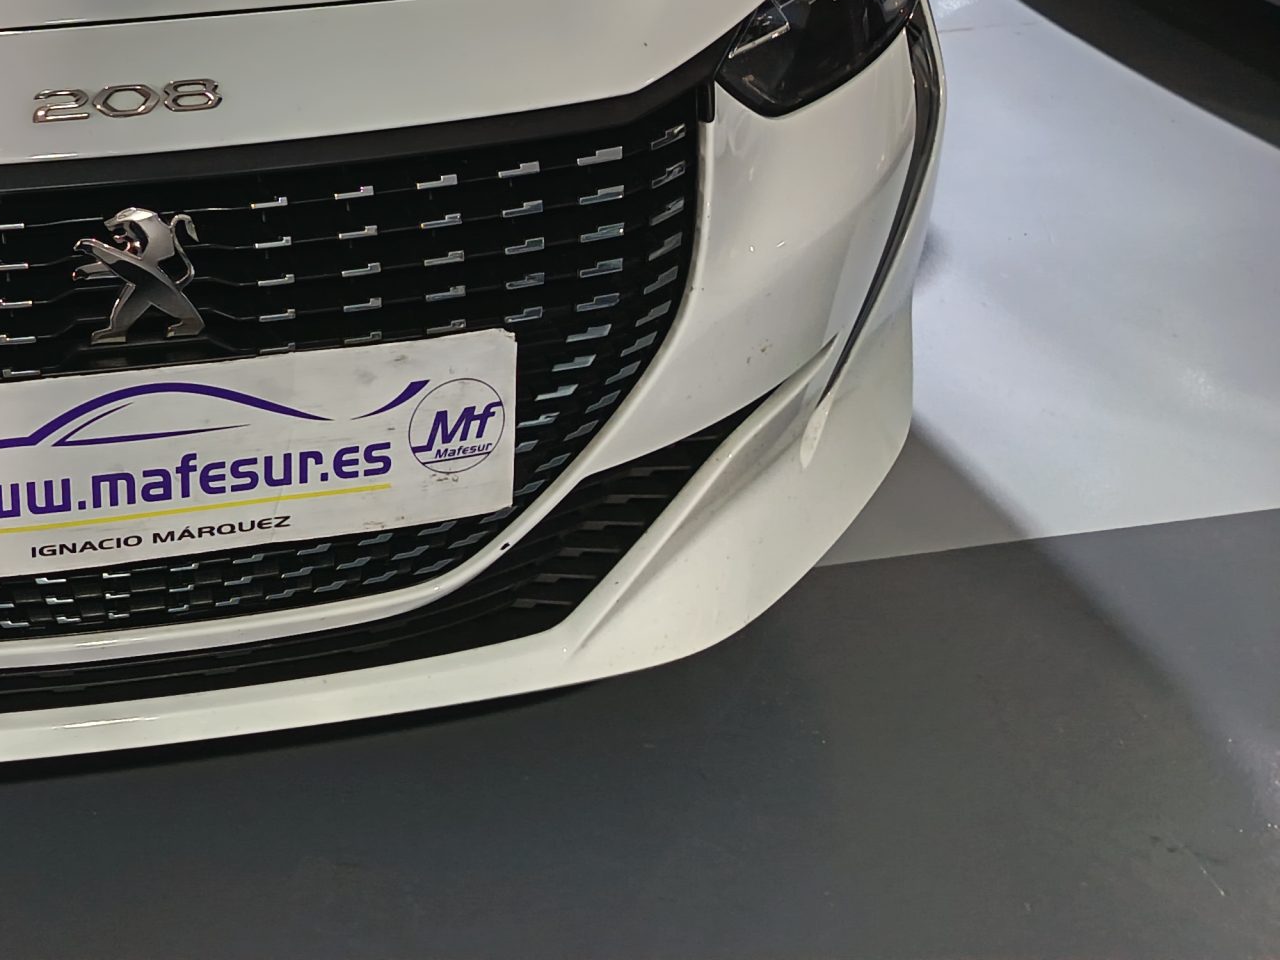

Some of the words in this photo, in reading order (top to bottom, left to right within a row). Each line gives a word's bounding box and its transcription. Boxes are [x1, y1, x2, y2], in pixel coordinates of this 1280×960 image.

[32, 78, 223, 124] 208
[434, 441, 494, 460] Mafesur
[31, 534, 142, 558] IGNACIO
[152, 515, 292, 544] MÁRQUEZ
